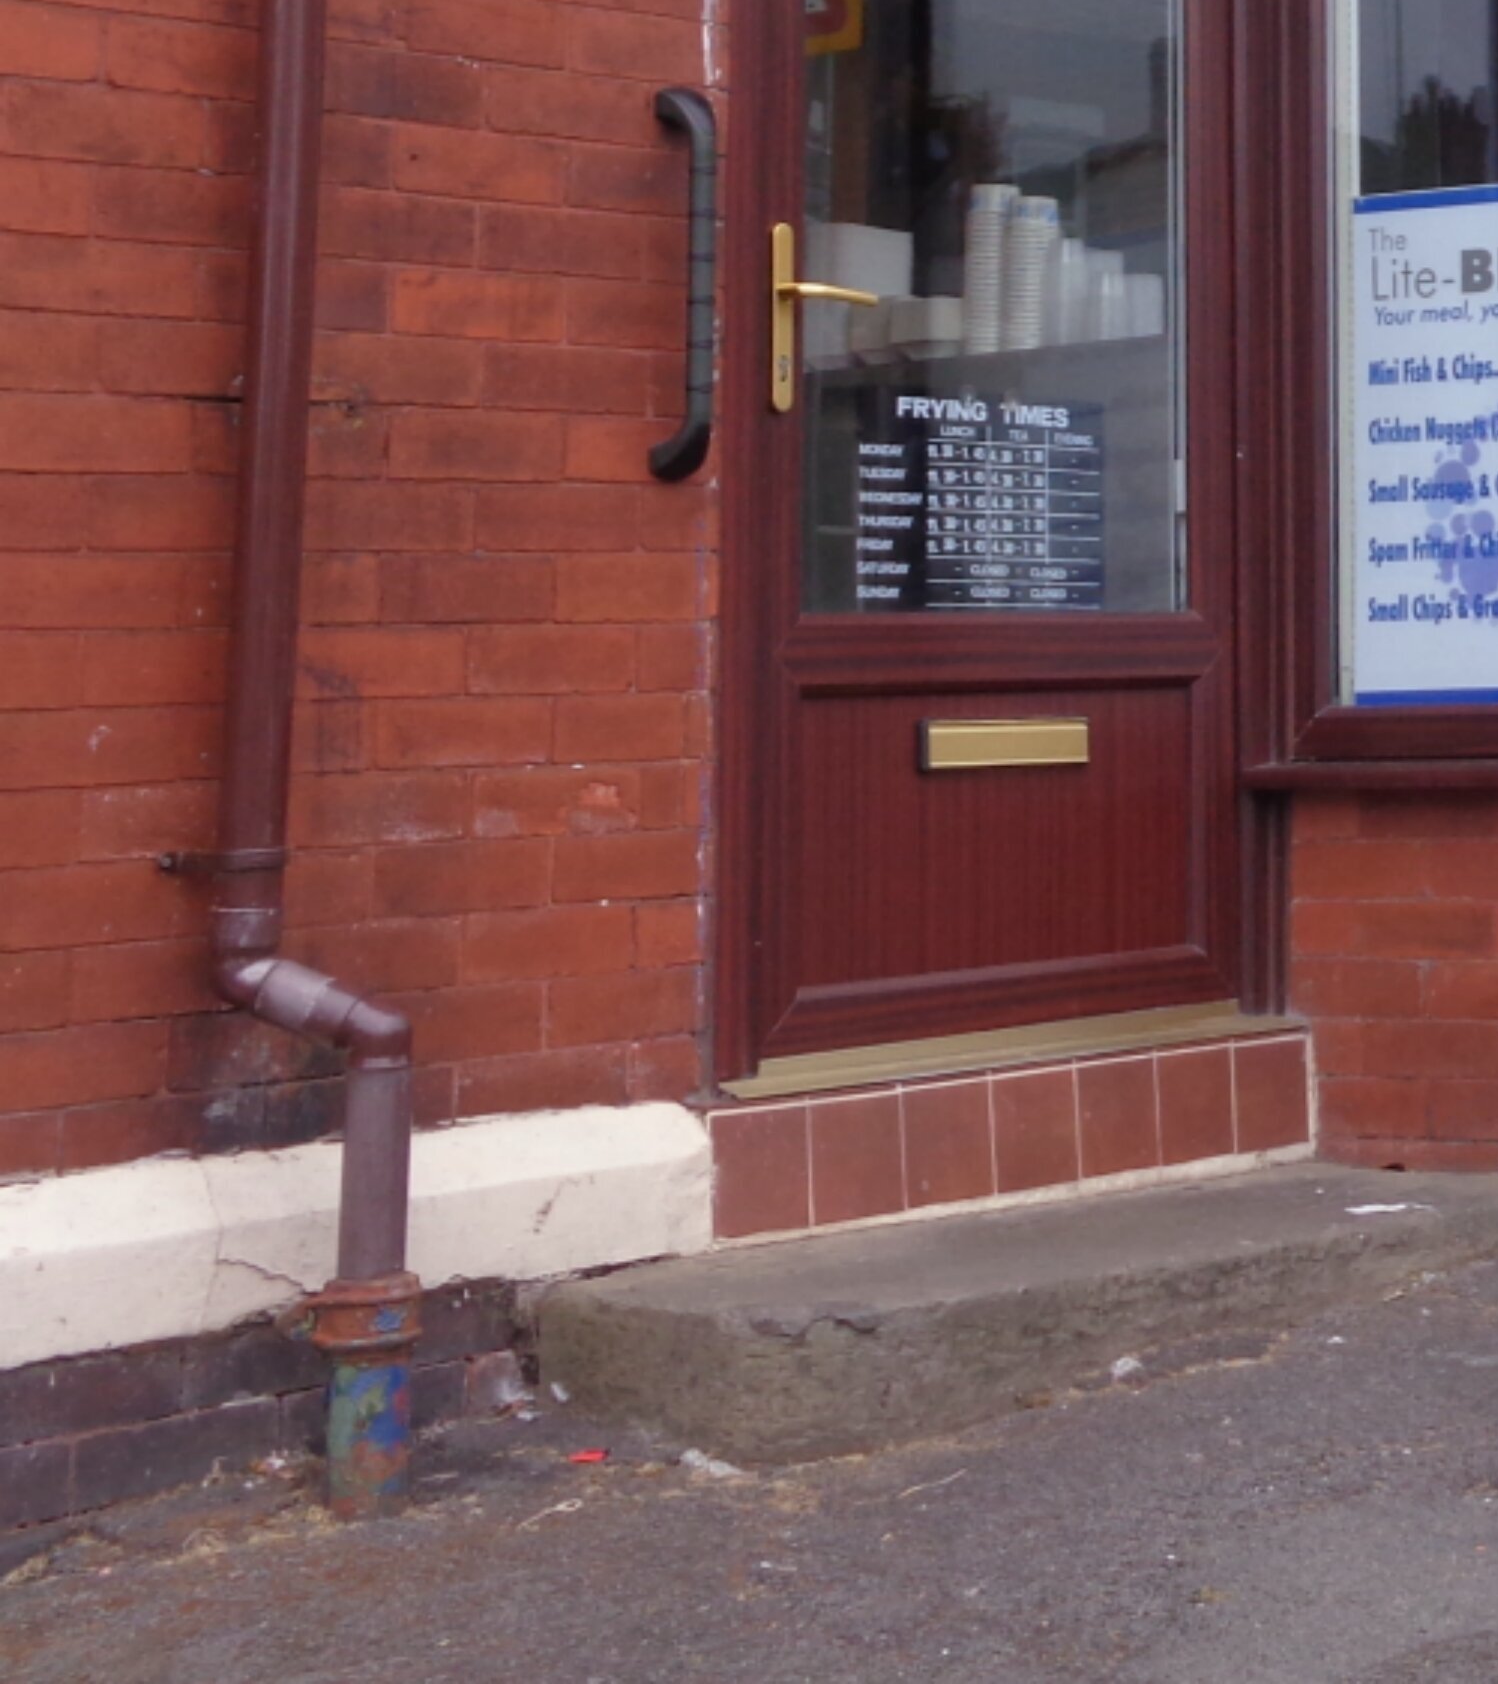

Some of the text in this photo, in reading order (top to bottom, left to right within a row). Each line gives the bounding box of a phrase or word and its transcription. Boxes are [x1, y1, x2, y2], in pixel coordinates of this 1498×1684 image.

[1368, 227, 1407, 253] The
[1374, 305, 1414, 327] Your
[1419, 300, 1475, 324] meal,
[1368, 358, 1401, 385] Mini
[1403, 356, 1434, 382] Fish
[1437, 357, 1449, 380] &
[896, 396, 1070, 428] FRYING TIMES
[1368, 417, 1422, 445] Chicken
[1426, 416, 1488, 445] Nuggets
[1368, 476, 1409, 503] Small
[1412, 474, 1476, 505] Sausage
[1479, 473, 1490, 498] &
[1368, 537, 1410, 565] Spam
[1412, 534, 1459, 561] Fritter
[1463, 535, 1475, 559] &
[1368, 596, 1409, 622] Small
[1412, 595, 1454, 625] Chips
